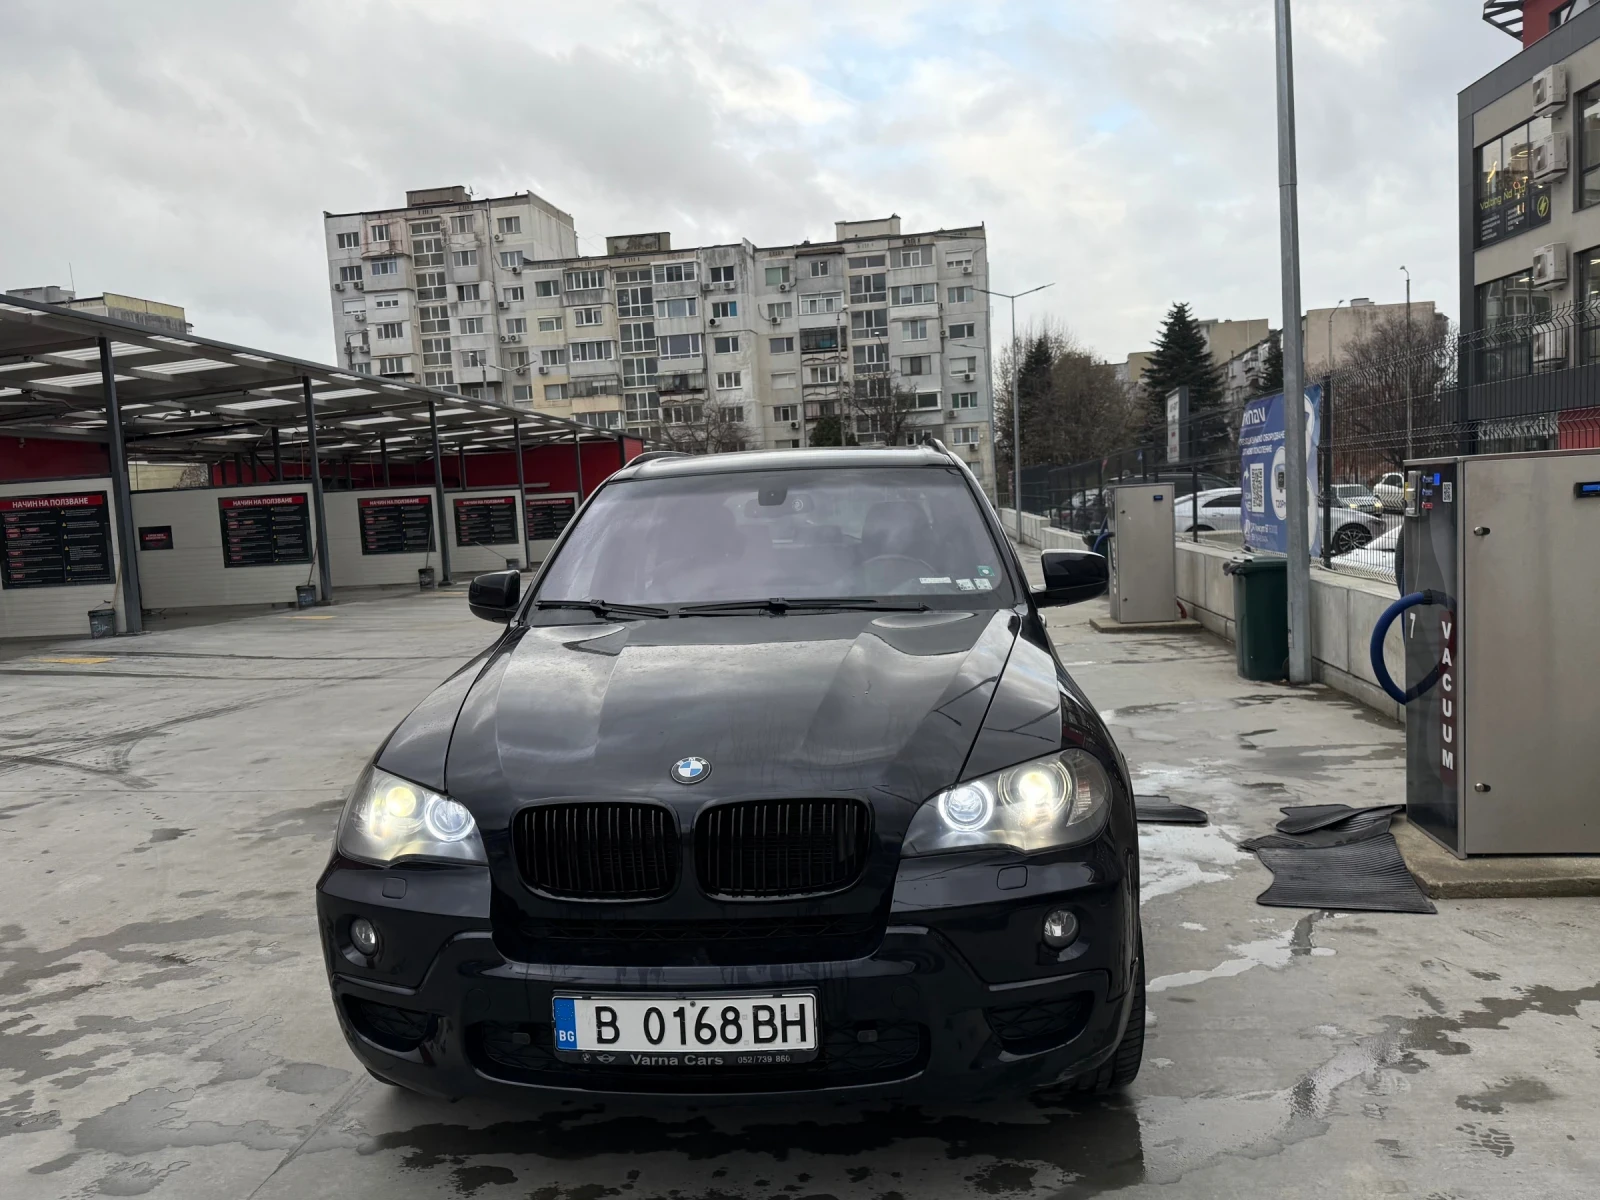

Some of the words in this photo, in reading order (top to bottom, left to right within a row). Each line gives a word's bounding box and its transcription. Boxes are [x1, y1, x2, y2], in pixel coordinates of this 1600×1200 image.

[12, 500, 38, 509] НАЧИН
[50, 497, 89, 507] ПОЛЗВАНЕ
[262, 497, 293, 505] ПОЛЗВАНЕ
[1409, 612, 1416, 639] 7
[1441, 620, 1454, 770] VACUUM
[595, 1005, 620, 1044] B
[559, 1030, 575, 1042] BG
[630, 1054, 679, 1066] Varna
[684, 1054, 724, 1066] Cars
[737, 1055, 773, 1064] 052/739
